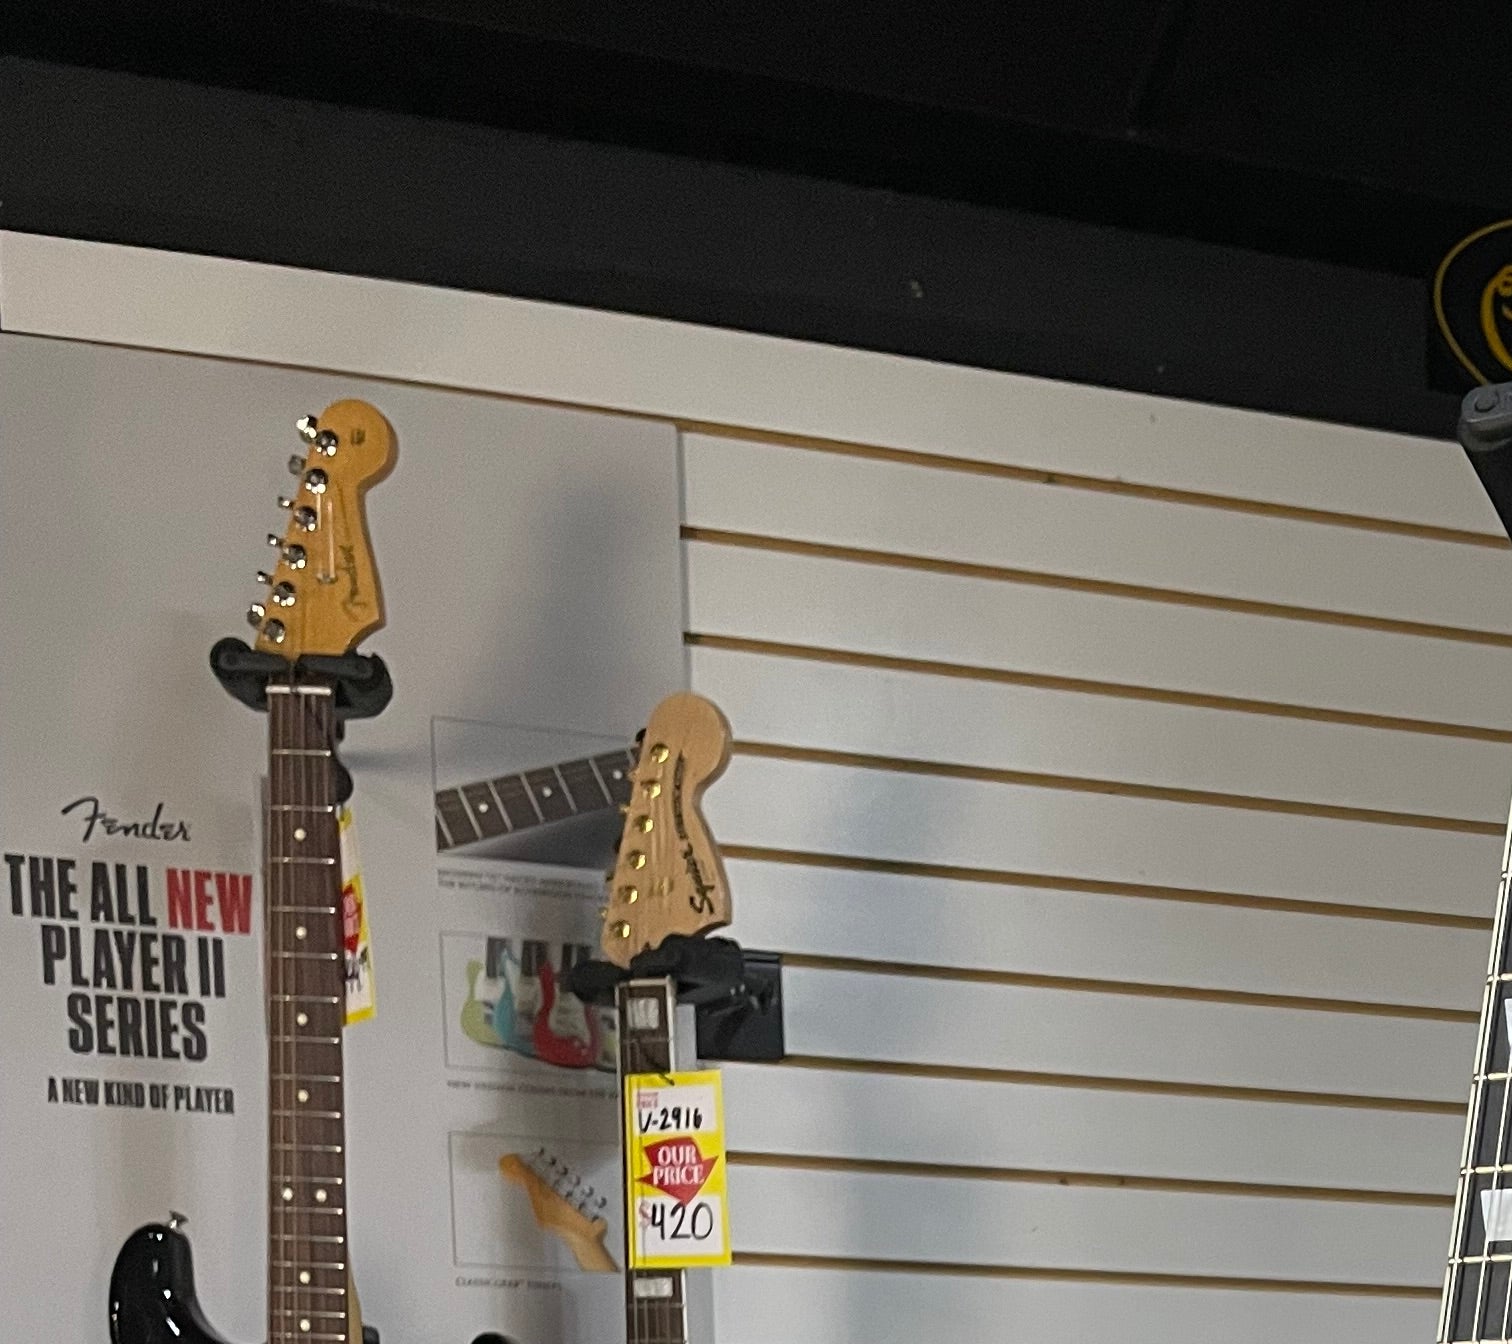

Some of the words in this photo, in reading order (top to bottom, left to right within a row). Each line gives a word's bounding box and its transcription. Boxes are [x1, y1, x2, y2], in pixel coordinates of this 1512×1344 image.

[61, 797, 192, 844] Fender
[4, 853, 79, 921] THE
[90, 862, 157, 926] ALL
[166, 868, 253, 935] NEW
[41, 924, 189, 996] PLAYER
[197, 937, 227, 998] II
[66, 993, 209, 1062] SERIES
[47, 1076, 58, 1103] A
[62, 1078, 99, 1106] NEW
[103, 1080, 146, 1109] KIND
[149, 1083, 170, 1109] OF
[174, 1084, 235, 1114] PLAYER
[652, 1165, 705, 1186] PRICE
[657, 1144, 697, 1166] OUR
